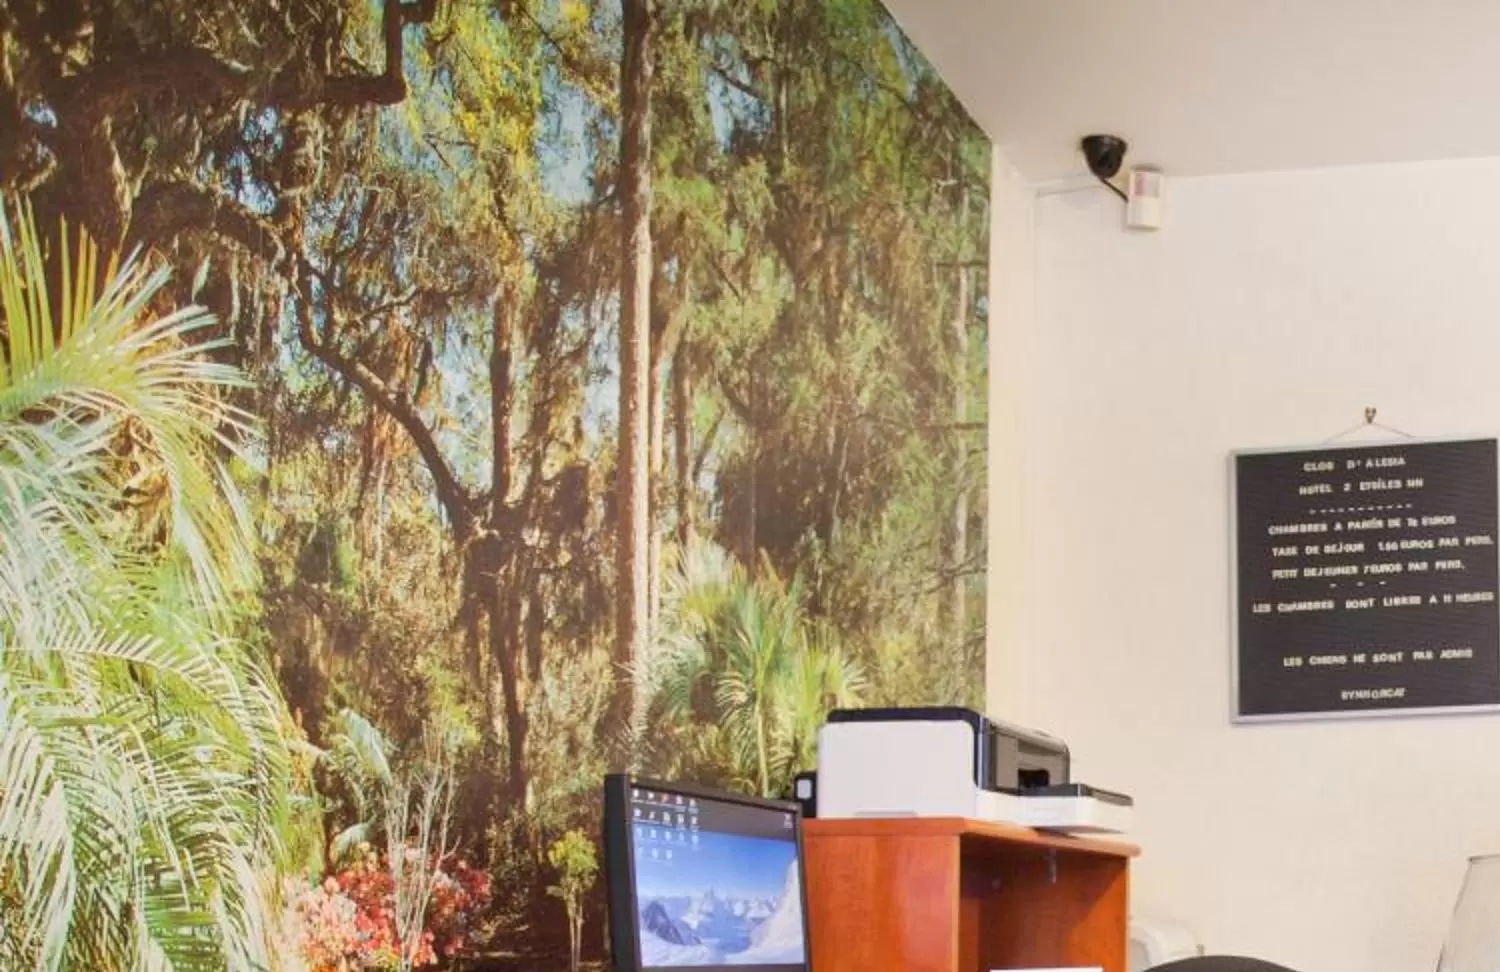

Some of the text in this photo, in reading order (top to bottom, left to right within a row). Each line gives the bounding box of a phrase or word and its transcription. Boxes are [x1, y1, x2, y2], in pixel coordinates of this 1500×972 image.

[1303, 461, 1335, 472] CLOS
[1421, 515, 1456, 527] EUROS
[1305, 545, 1320, 556] DE
[1438, 536, 1459, 547] PAR
[1408, 561, 1428, 572] PAR
[1252, 602, 1271, 613] LES
[1345, 597, 1376, 609] SONT
[1429, 594, 1438, 605] A
[1283, 656, 1303, 667] LES
[1352, 653, 1366, 664] NE
[1372, 652, 1404, 663] SONT
